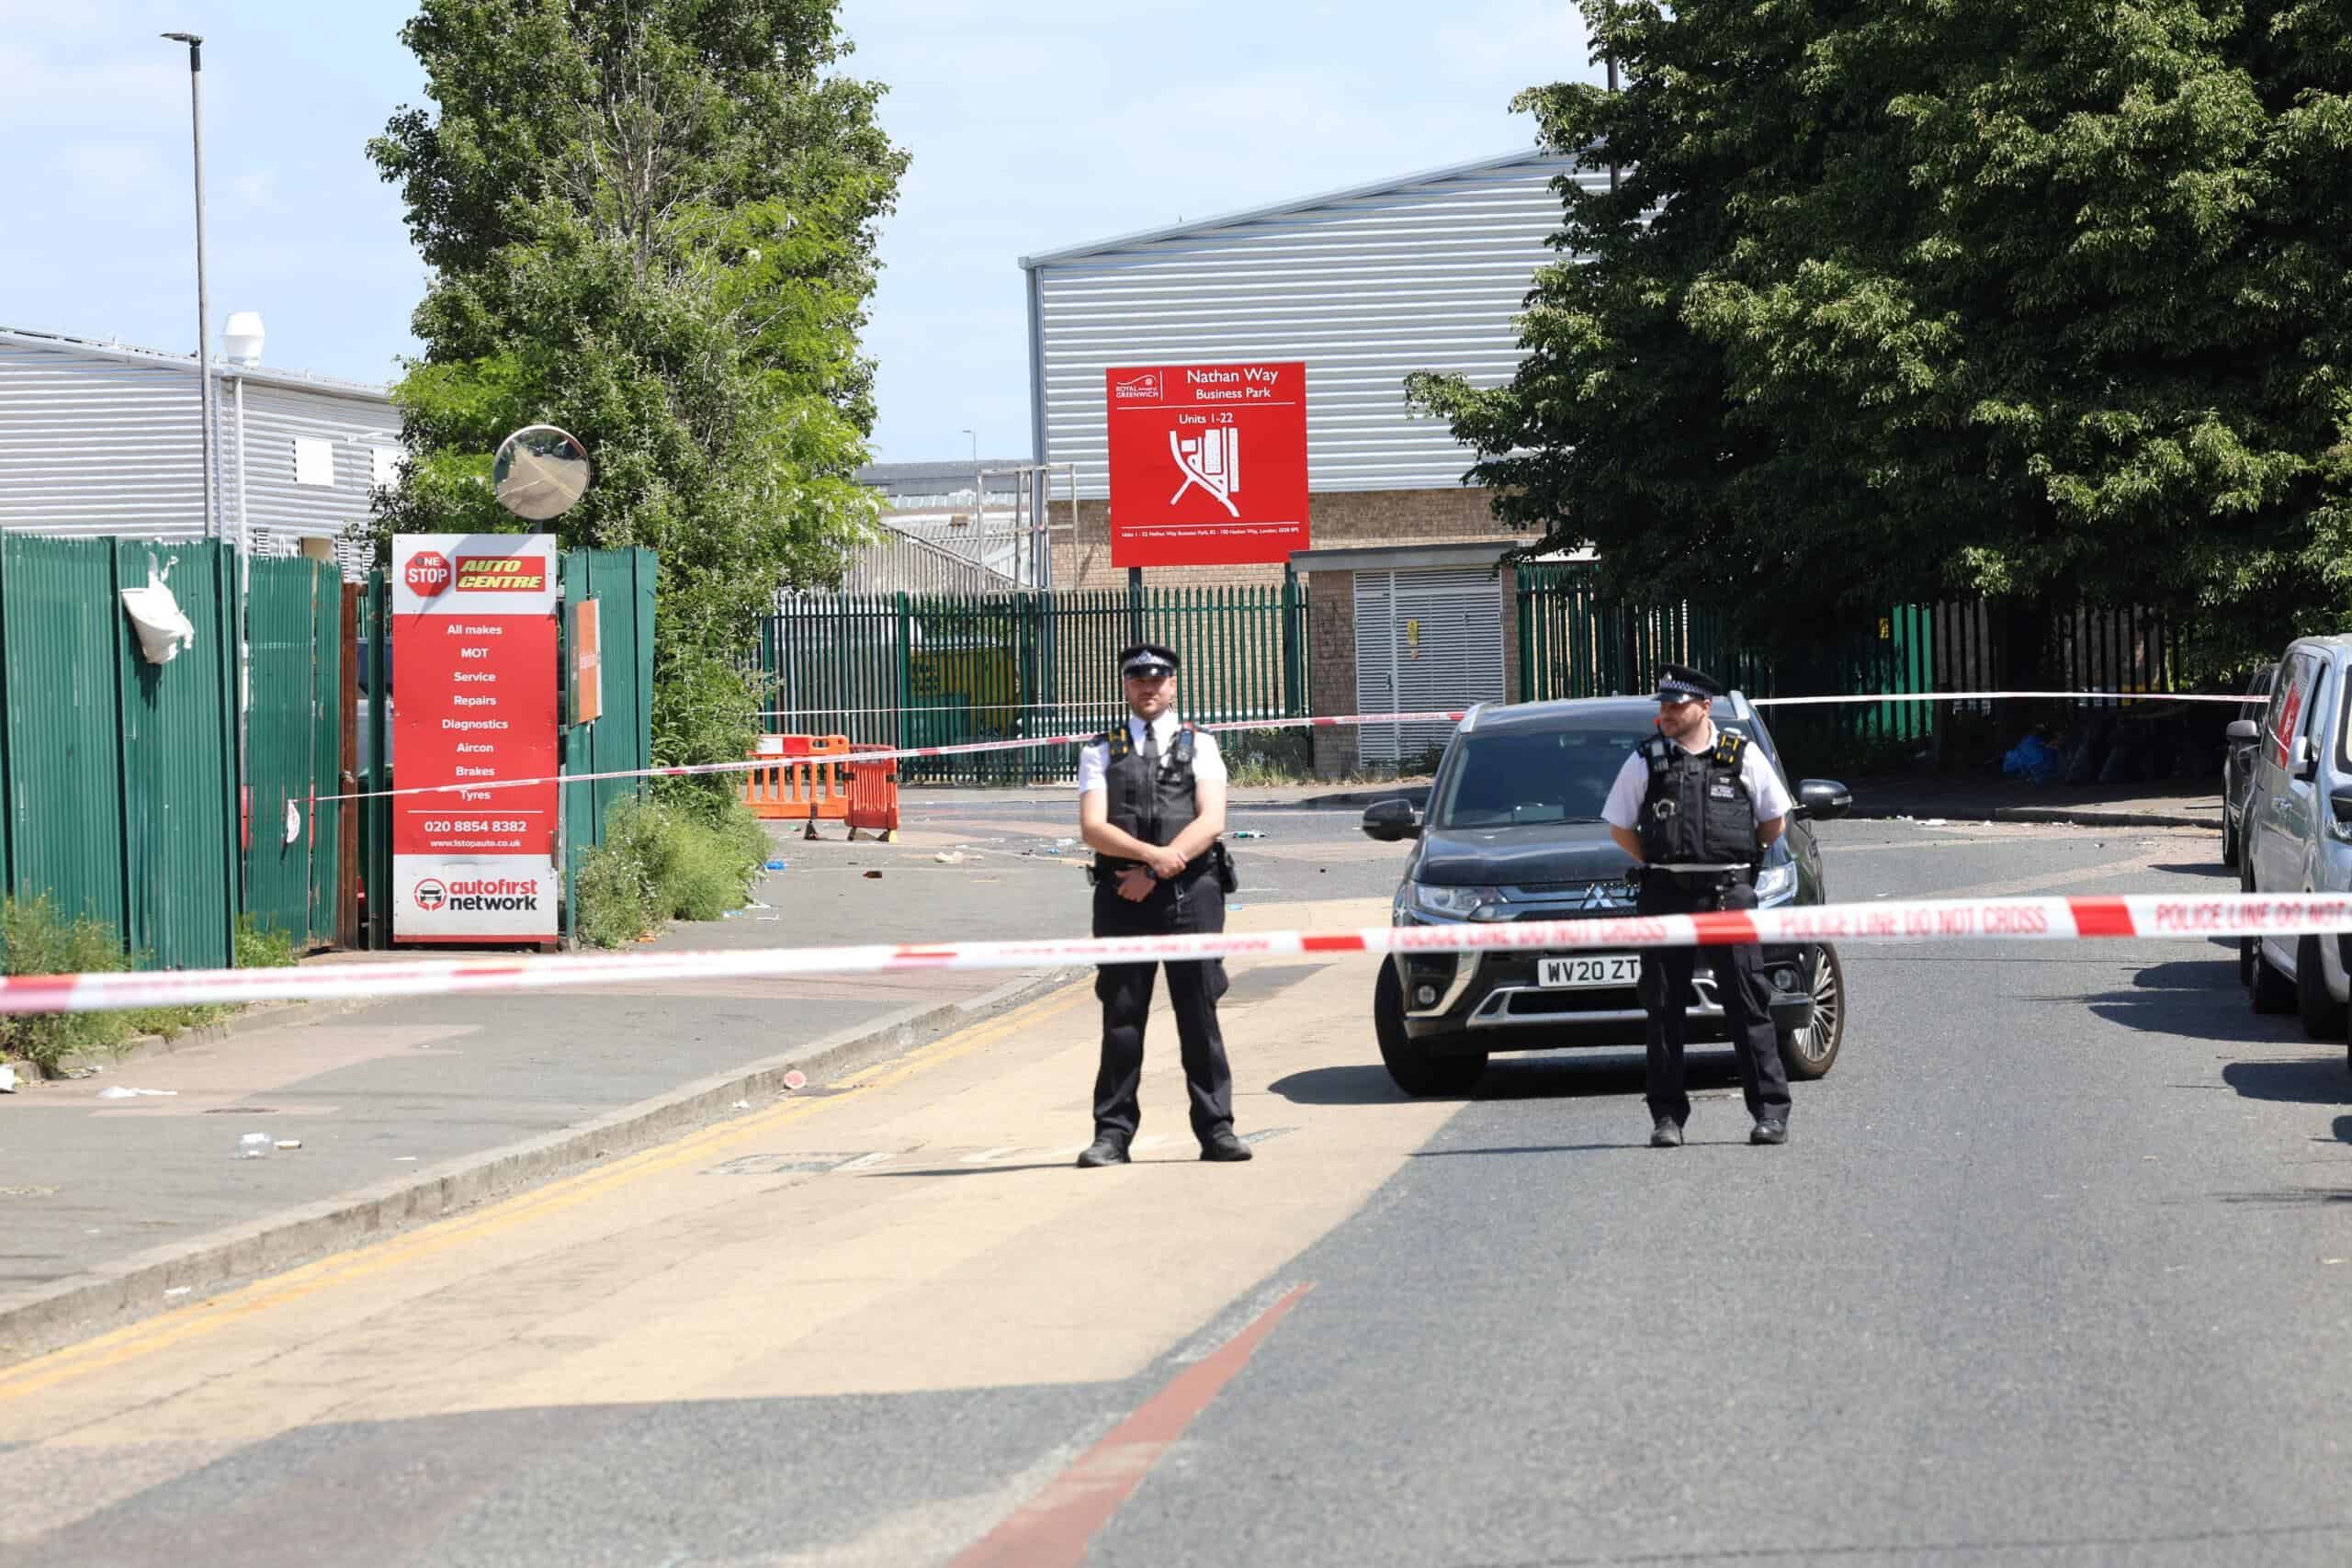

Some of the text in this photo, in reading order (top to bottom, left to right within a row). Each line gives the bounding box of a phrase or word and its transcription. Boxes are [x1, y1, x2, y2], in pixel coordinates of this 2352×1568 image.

[1187, 367, 1278, 384] Nathan Way
[1196, 388, 1271, 400] Business Park
[1179, 412, 1233, 424] Units 1-22
[460, 559, 522, 572] AUTO
[408, 568, 447, 583] STOP
[458, 576, 542, 589] CENTRE
[447, 625, 503, 635] All makes
[461, 649, 489, 658] MOT
[454, 671, 496, 682] Service
[454, 695, 497, 706] Repairs
[442, 718, 509, 730] Diagnostics
[457, 742, 493, 753] Aircon
[456, 766, 495, 776] Brakes
[460, 789, 492, 802] Tyres
[424, 820, 527, 832] 020 8854 8382
[450, 879, 537, 895] autofirst
[450, 896, 537, 910] network
[1981, 905, 2049, 934] CROSS
[2155, 903, 2222, 931] POLICE
[2227, 902, 2267, 929] LINE
[1547, 959, 1639, 983] WV20 ZT
